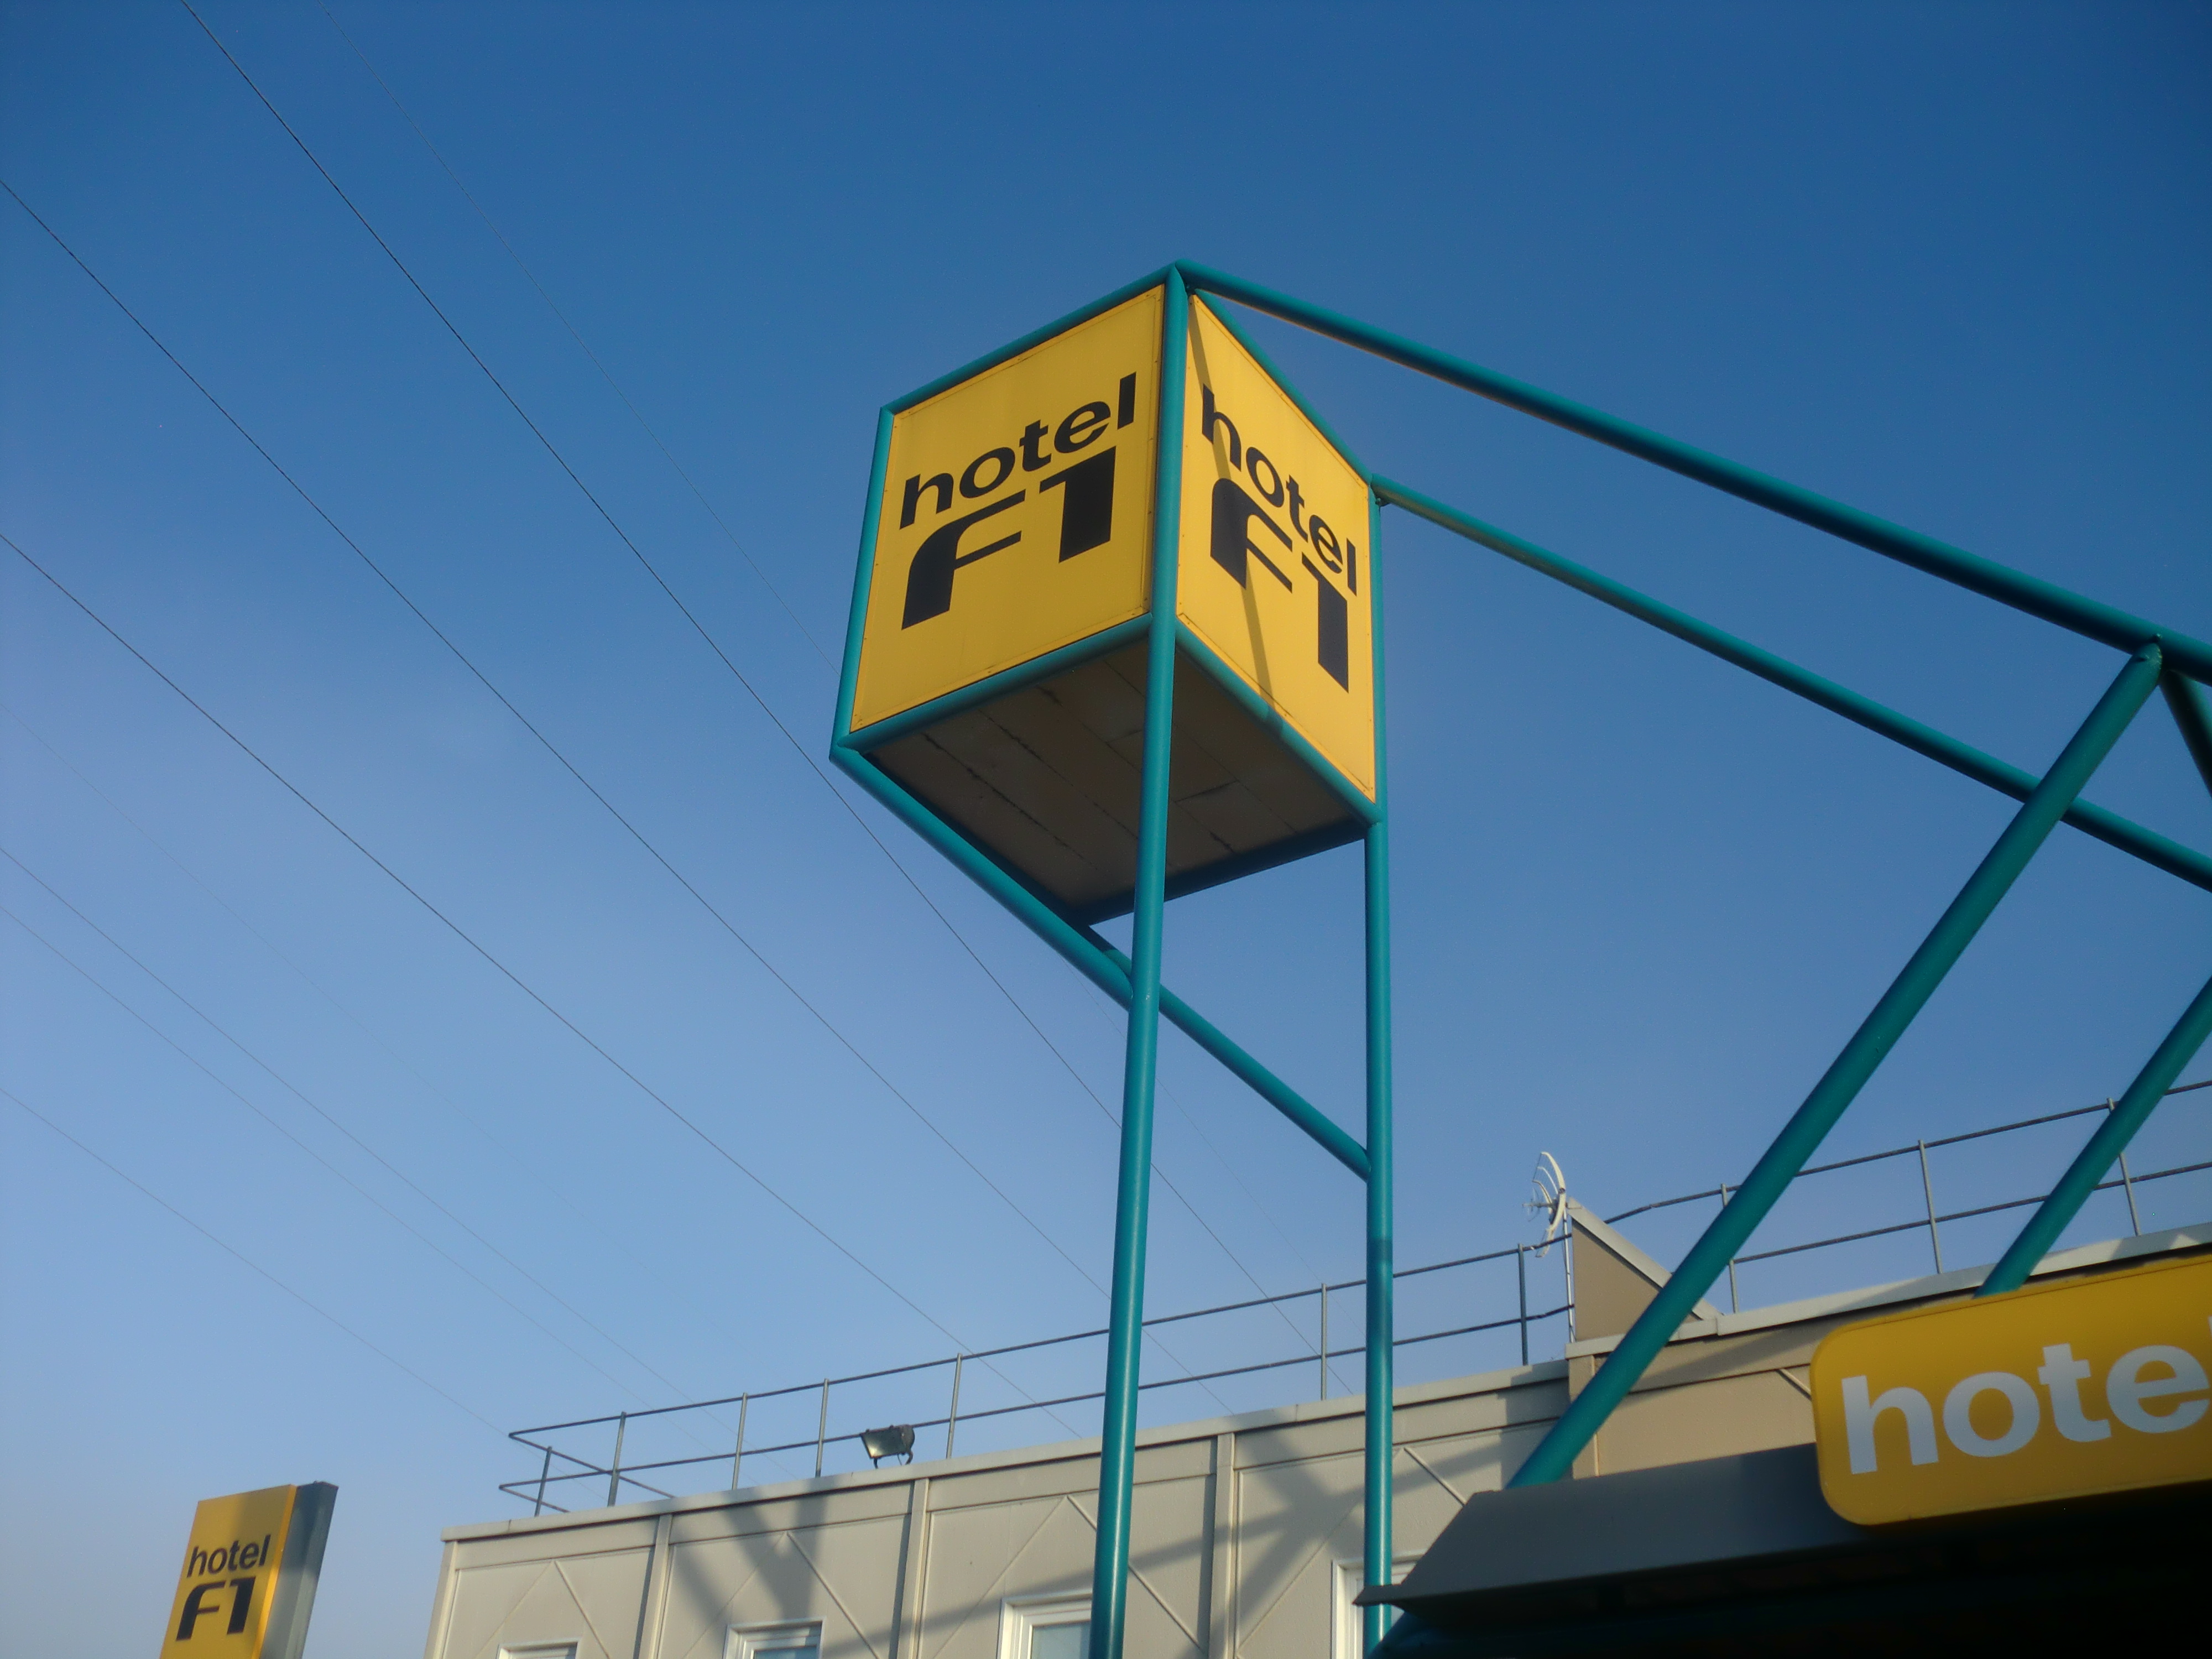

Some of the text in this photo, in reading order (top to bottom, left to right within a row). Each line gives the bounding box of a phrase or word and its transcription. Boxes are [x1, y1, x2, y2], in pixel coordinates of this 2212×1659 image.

[899, 372, 1136, 530] hotel
[1201, 383, 1357, 597] hotel
[901, 445, 1117, 630] F1
[1209, 477, 1349, 693] F1
[1841, 1315, 2212, 1475] hote
[175, 1576, 256, 1642] F1
[186, 1533, 271, 1578] hotel
